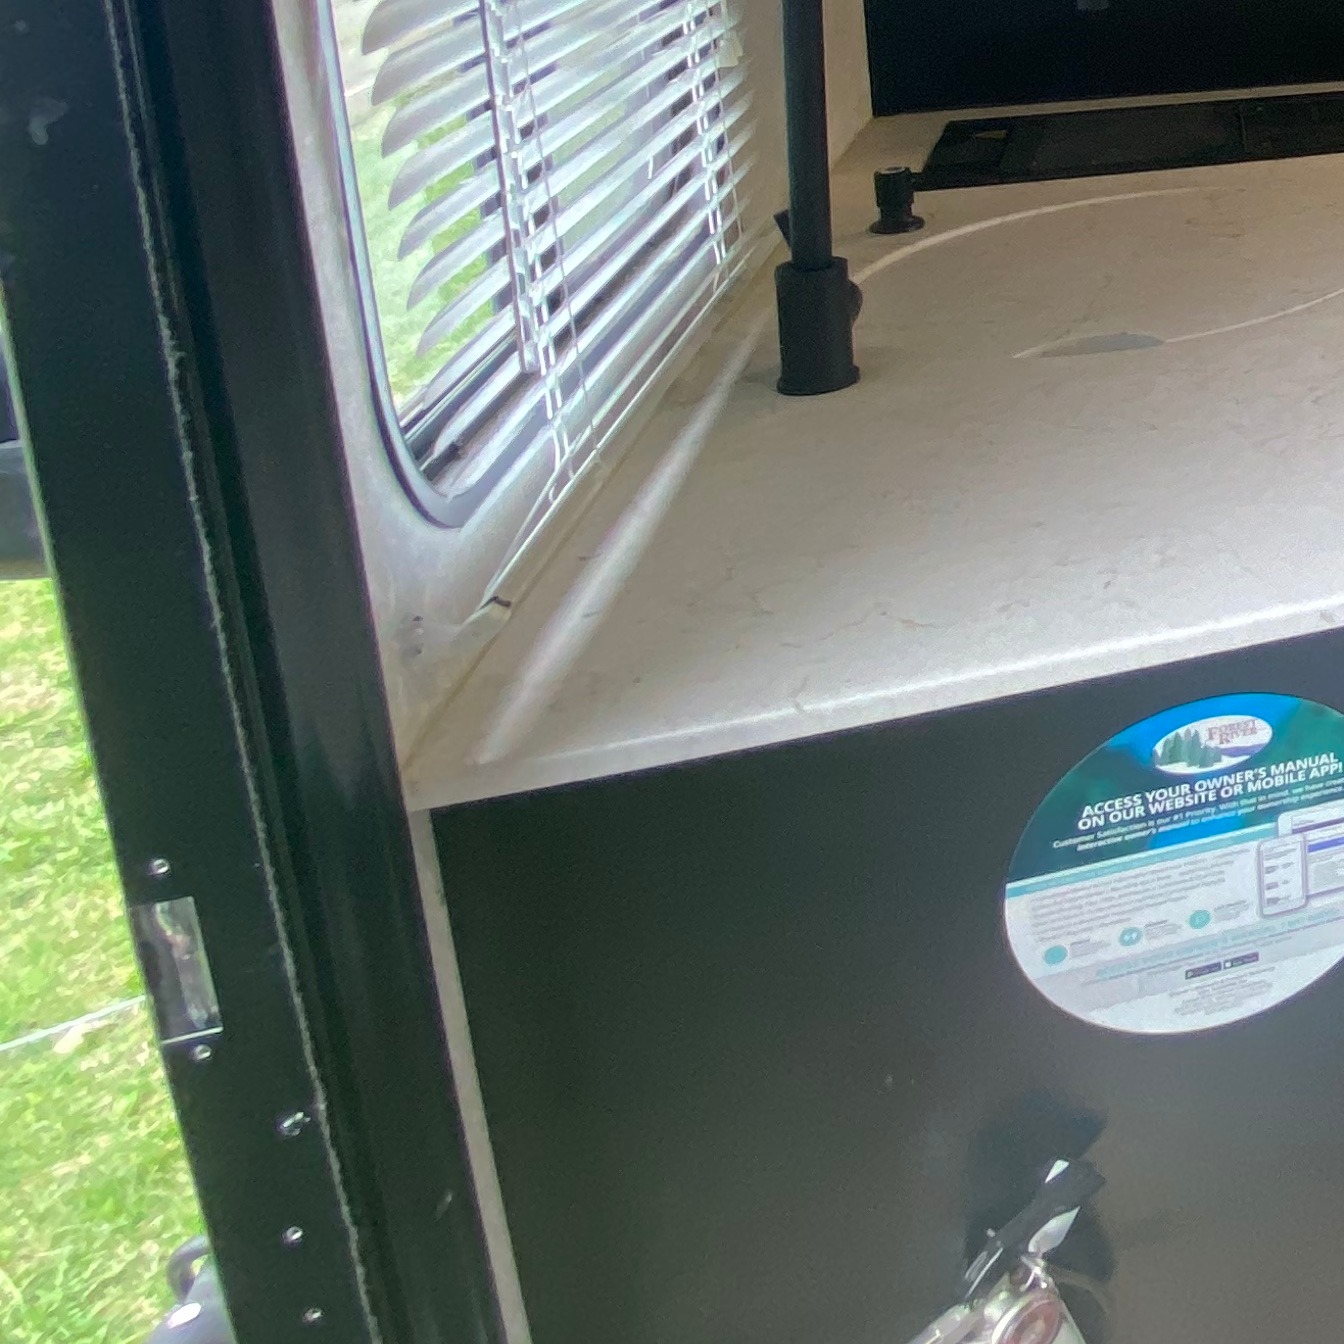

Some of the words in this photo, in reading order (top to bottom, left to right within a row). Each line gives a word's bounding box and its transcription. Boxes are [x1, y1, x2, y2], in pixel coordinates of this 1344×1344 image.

[1077, 815, 1105, 831] ON
[1109, 806, 1146, 824] OUR
[1149, 790, 1217, 814] WEBSITE
[1220, 786, 1243, 798] OR
[1247, 771, 1306, 793] MOBILE
[1309, 762, 1343, 780] APP!
[1082, 793, 1142, 818] ACCESS
[1145, 783, 1190, 801] YOUR
[1194, 767, 1267, 793] OWNER'S
[1270, 752, 1339, 777] MANUAL
[1052, 834, 1095, 849] Customer
